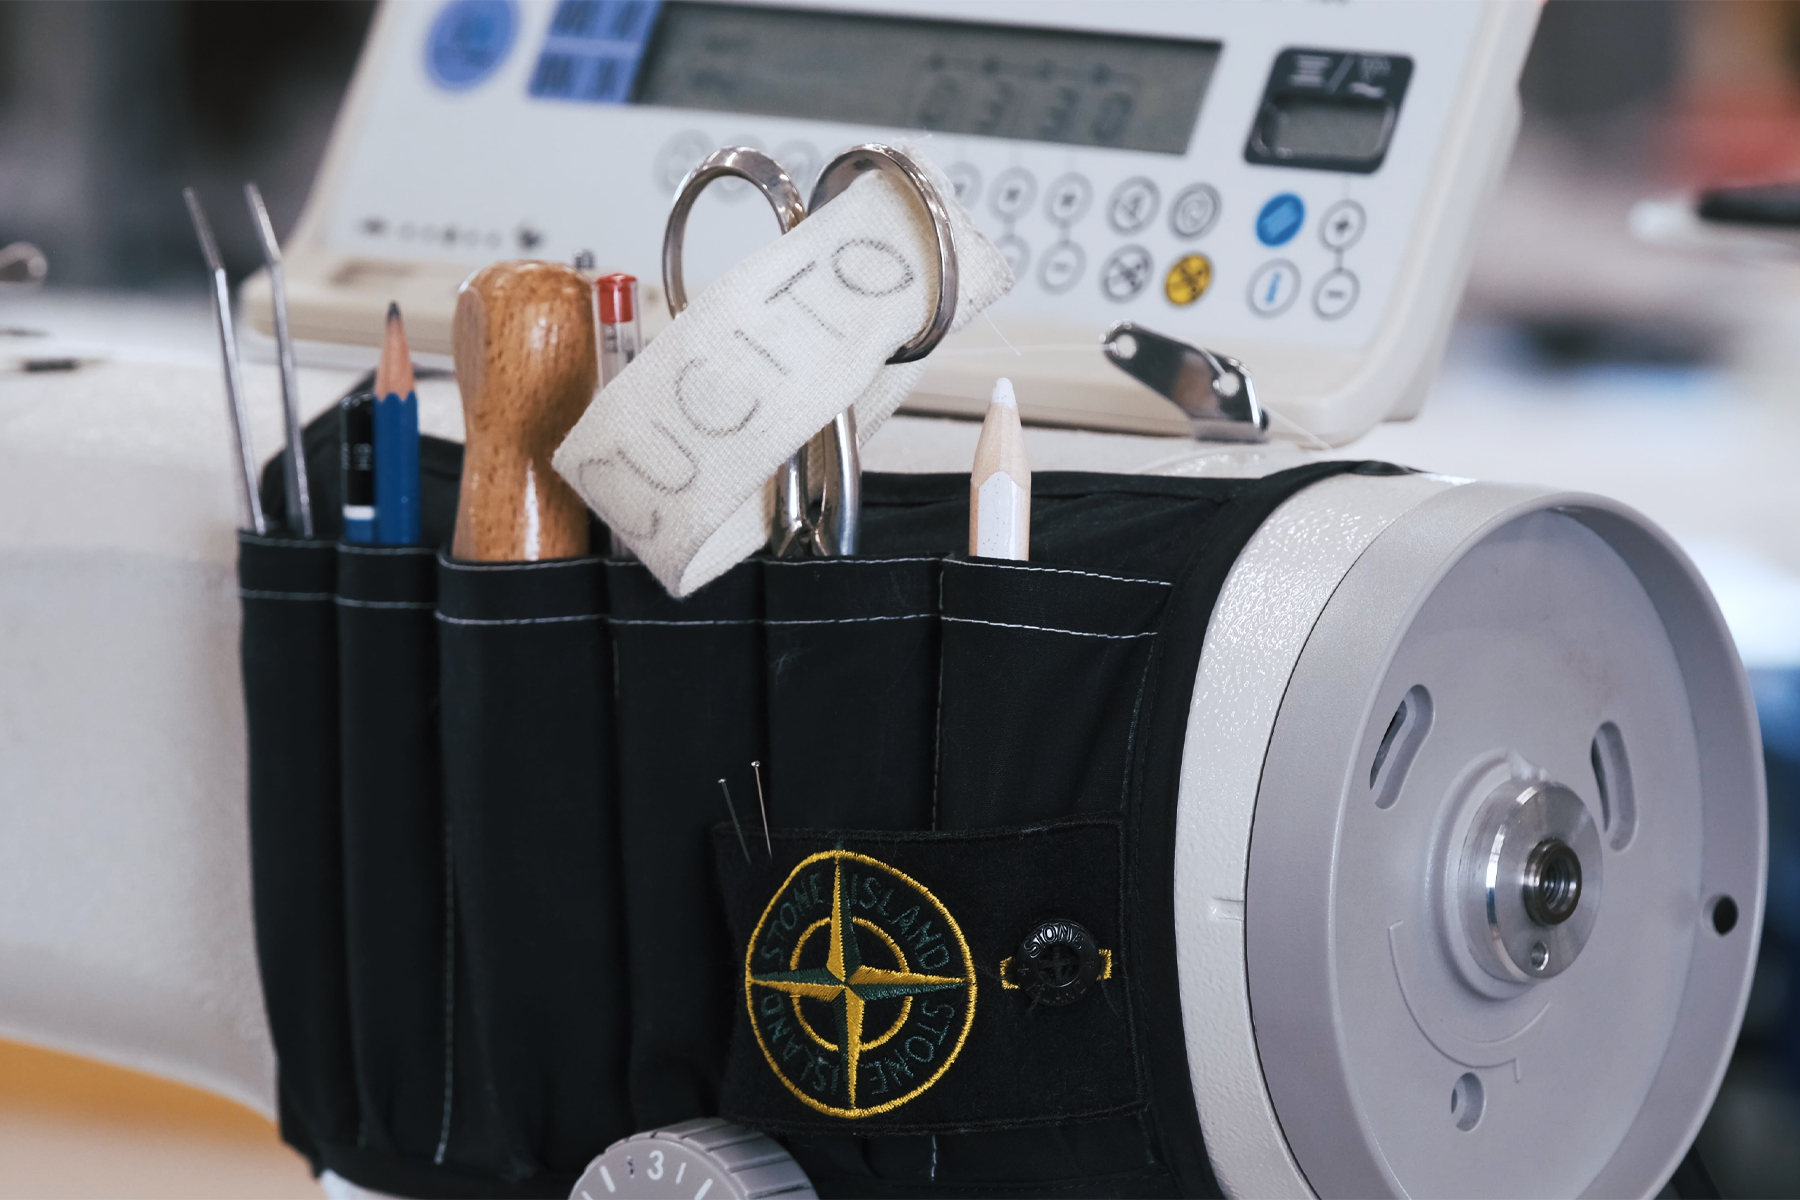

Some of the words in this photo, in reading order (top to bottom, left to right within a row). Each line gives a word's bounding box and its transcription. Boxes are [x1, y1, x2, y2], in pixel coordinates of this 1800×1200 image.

[578, 238, 915, 540] CUCITO
[761, 872, 825, 967] STONE
[850, 873, 950, 970] ISLAND
[1023, 923, 1086, 959] STONE
[760, 993, 841, 1095] ISLAND
[859, 1000, 955, 1095] STONE
[646, 1149, 665, 1181] 3
